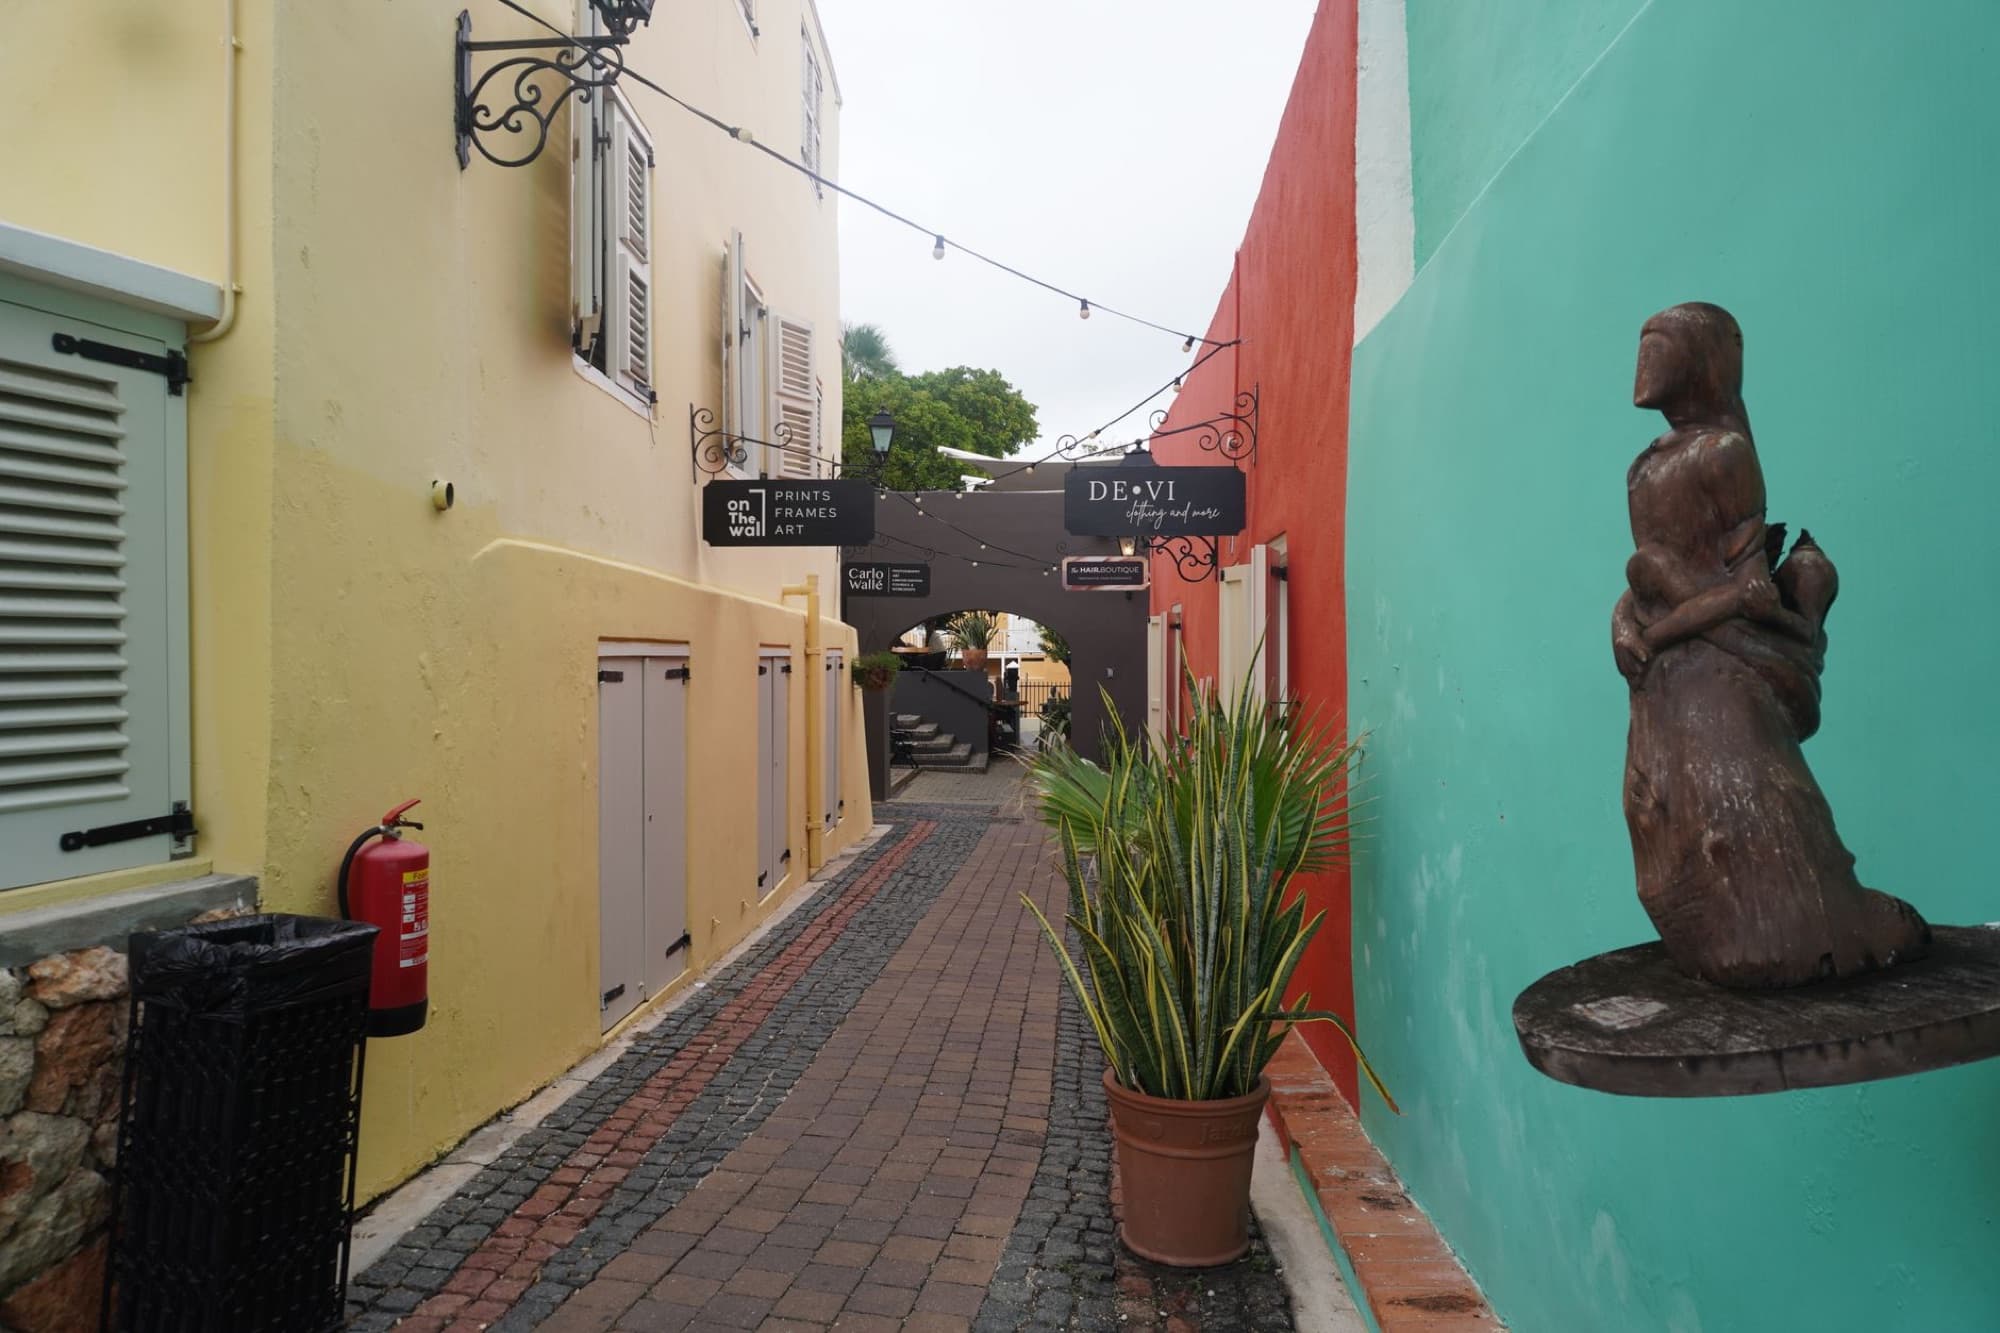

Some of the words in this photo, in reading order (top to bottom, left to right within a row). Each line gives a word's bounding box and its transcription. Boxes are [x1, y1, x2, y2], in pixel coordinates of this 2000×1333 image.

[774, 490, 831, 501] PRINTS
[727, 500, 750, 512] on
[728, 512, 757, 525] The
[774, 507, 838, 519] FRAMES
[1126, 499, 1168, 529] clothing
[1170, 501, 1192, 524] and
[1192, 507, 1221, 519] more
[774, 524, 804, 535] ART
[848, 567, 884, 579] Carlo
[848, 579, 883, 590] Wallé
